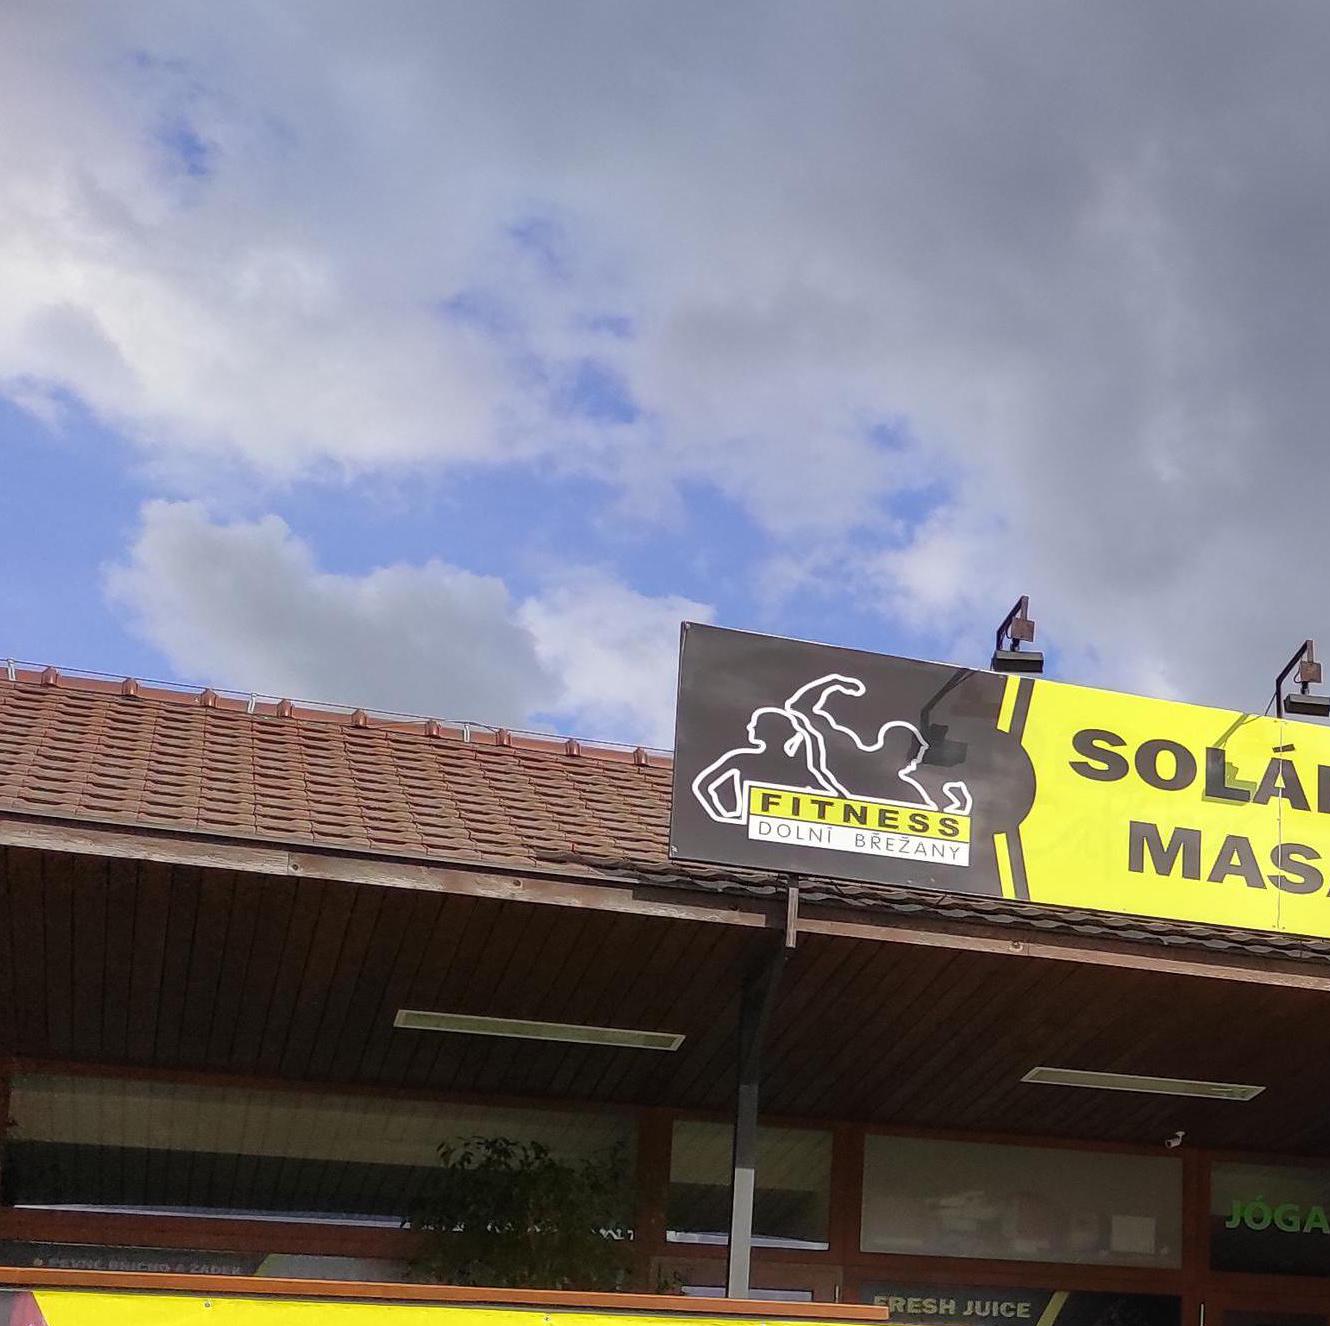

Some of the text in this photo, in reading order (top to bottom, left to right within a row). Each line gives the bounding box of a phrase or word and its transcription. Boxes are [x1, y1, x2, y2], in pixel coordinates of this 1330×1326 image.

[758, 790, 962, 838] FITNESS
[758, 820, 963, 864] DOLNÍ BŘEŽANY
[874, 1295, 1031, 1318] FRESH JUICE
